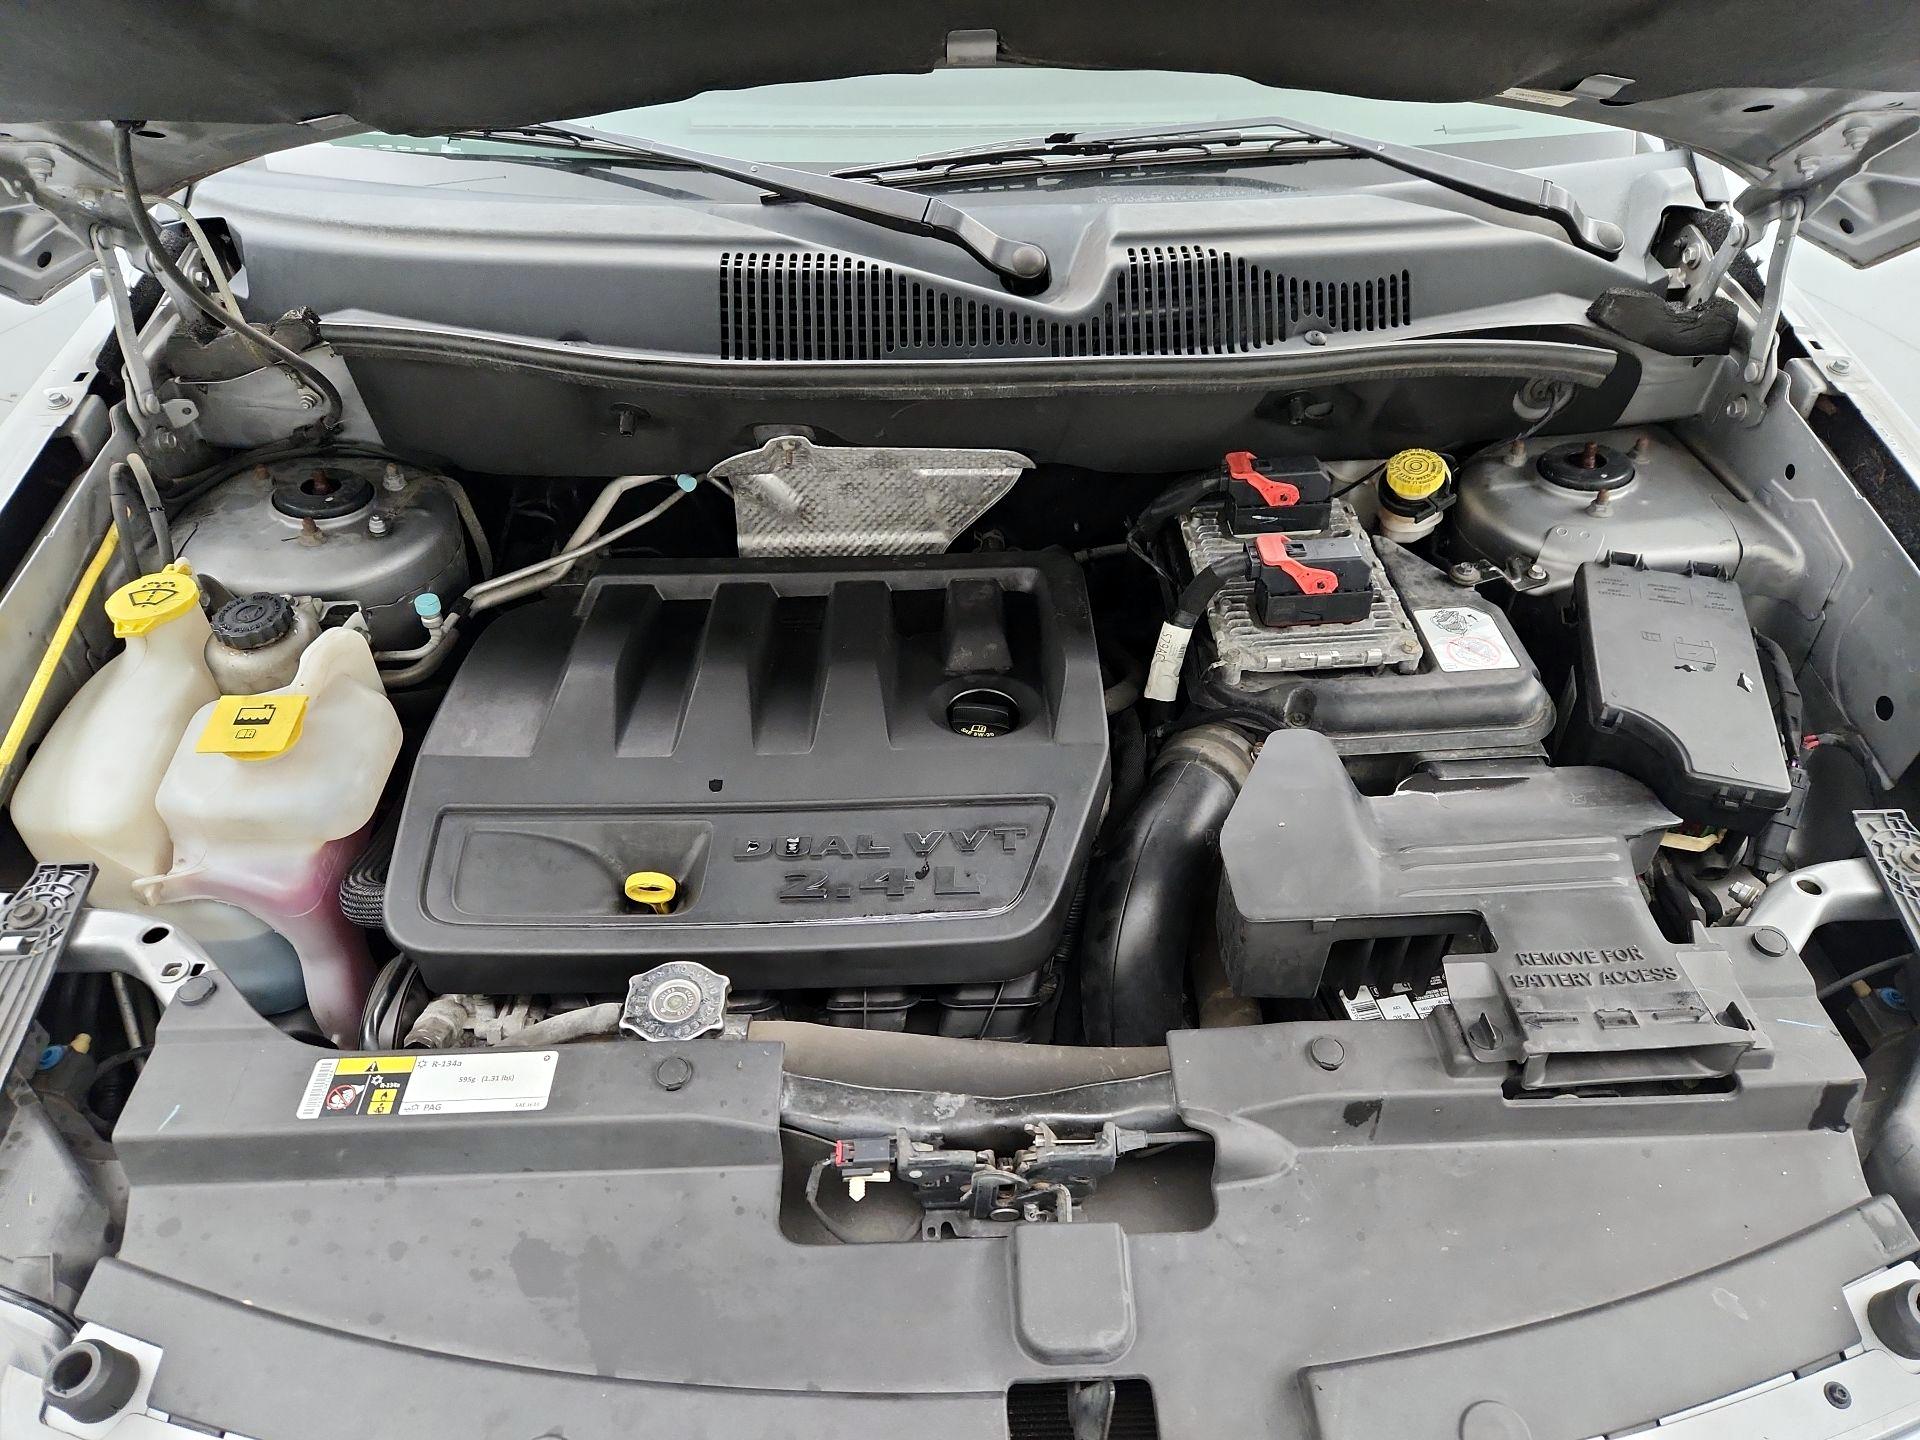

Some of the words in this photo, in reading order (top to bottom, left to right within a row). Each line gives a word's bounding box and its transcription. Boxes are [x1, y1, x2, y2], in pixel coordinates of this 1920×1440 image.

[734, 833, 891, 860] DUAL
[904, 826, 1028, 857] VVT
[1515, 950, 1600, 966] REMOVE
[1600, 945, 1646, 963] FOR
[1509, 971, 1594, 989] BATTERY
[1599, 966, 1679, 987] ACCESS
[432, 1060, 463, 1068] R-134a
[458, 1076, 476, 1084] 595g
[501, 1074, 515, 1082] lbs)
[423, 1103, 442, 1111] PAG
